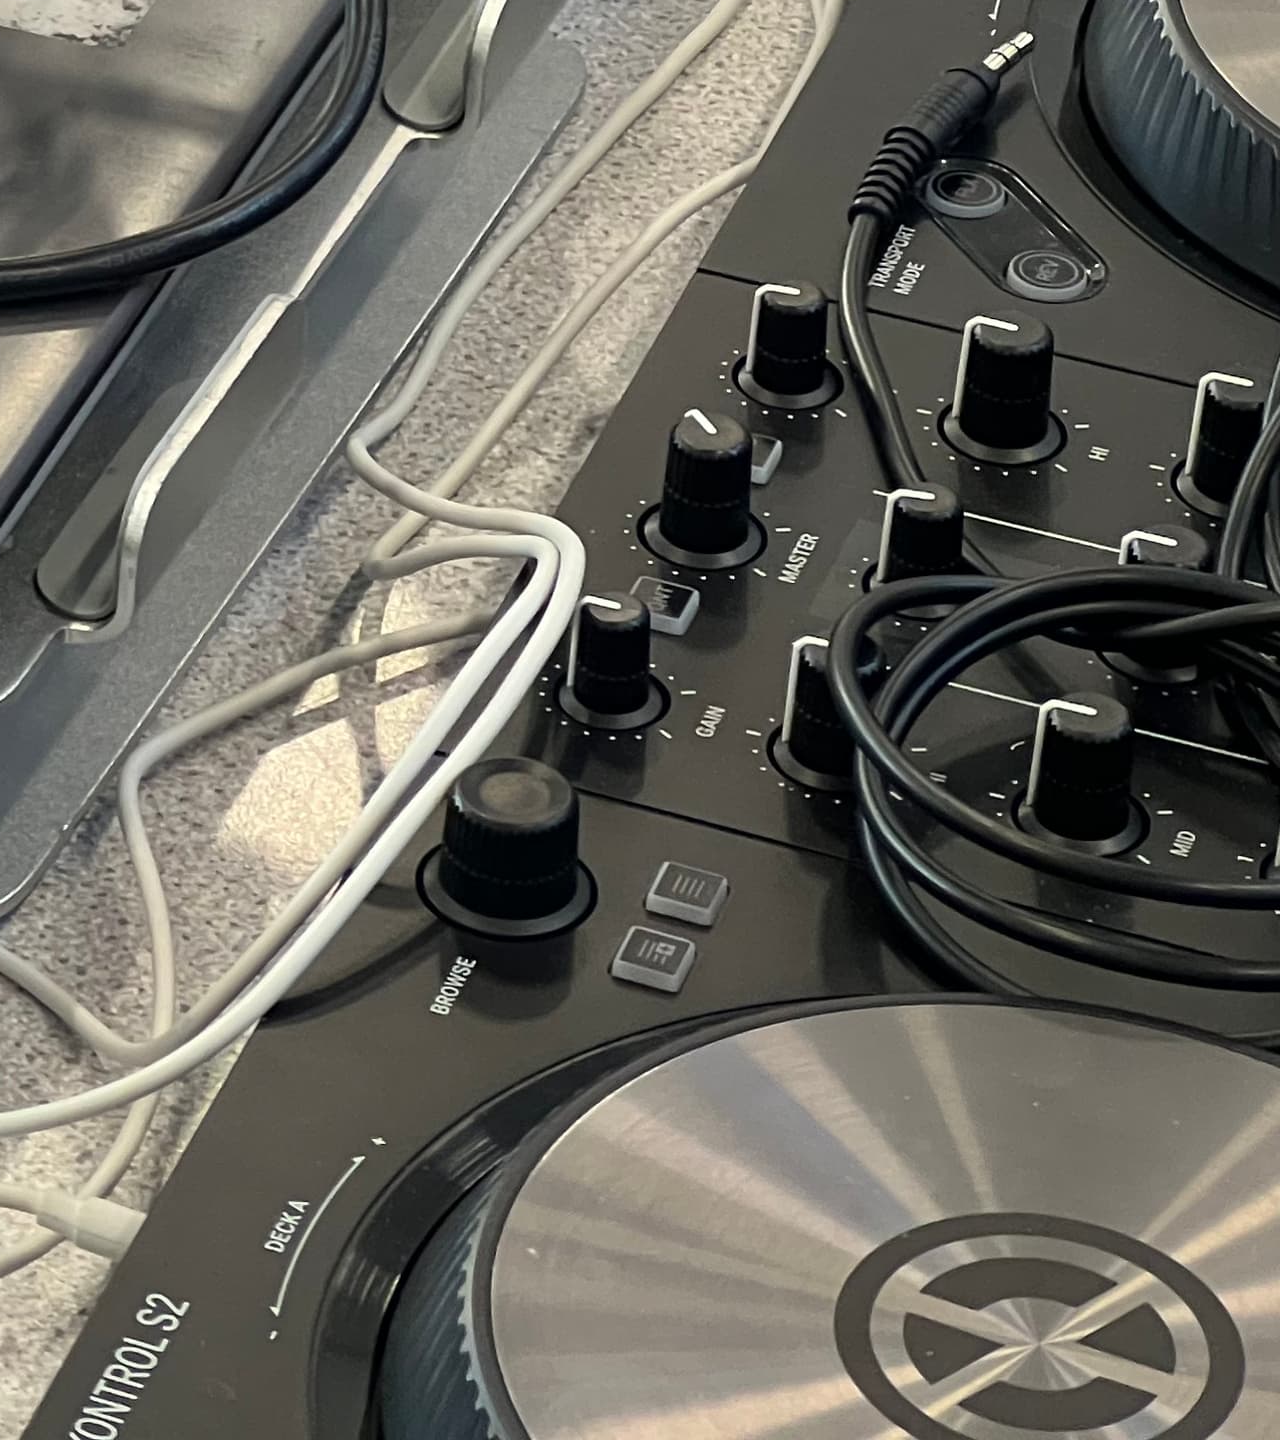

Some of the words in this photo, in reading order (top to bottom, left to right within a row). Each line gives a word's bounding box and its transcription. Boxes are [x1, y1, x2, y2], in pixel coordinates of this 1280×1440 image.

[868, 224, 916, 289] TRANSPORT
[893, 262, 926, 297] MODE
[1088, 446, 1110, 462] HI
[777, 532, 820, 585] MASTER
[695, 705, 727, 740] GAIN
[1169, 830, 1197, 858] MID
[429, 955, 477, 1017] BROWSE
[263, 1211, 303, 1253] DECK
[288, 1200, 310, 1213] A
[68, 1336, 170, 1440] ONTROL
[136, 1292, 191, 1333] S2
